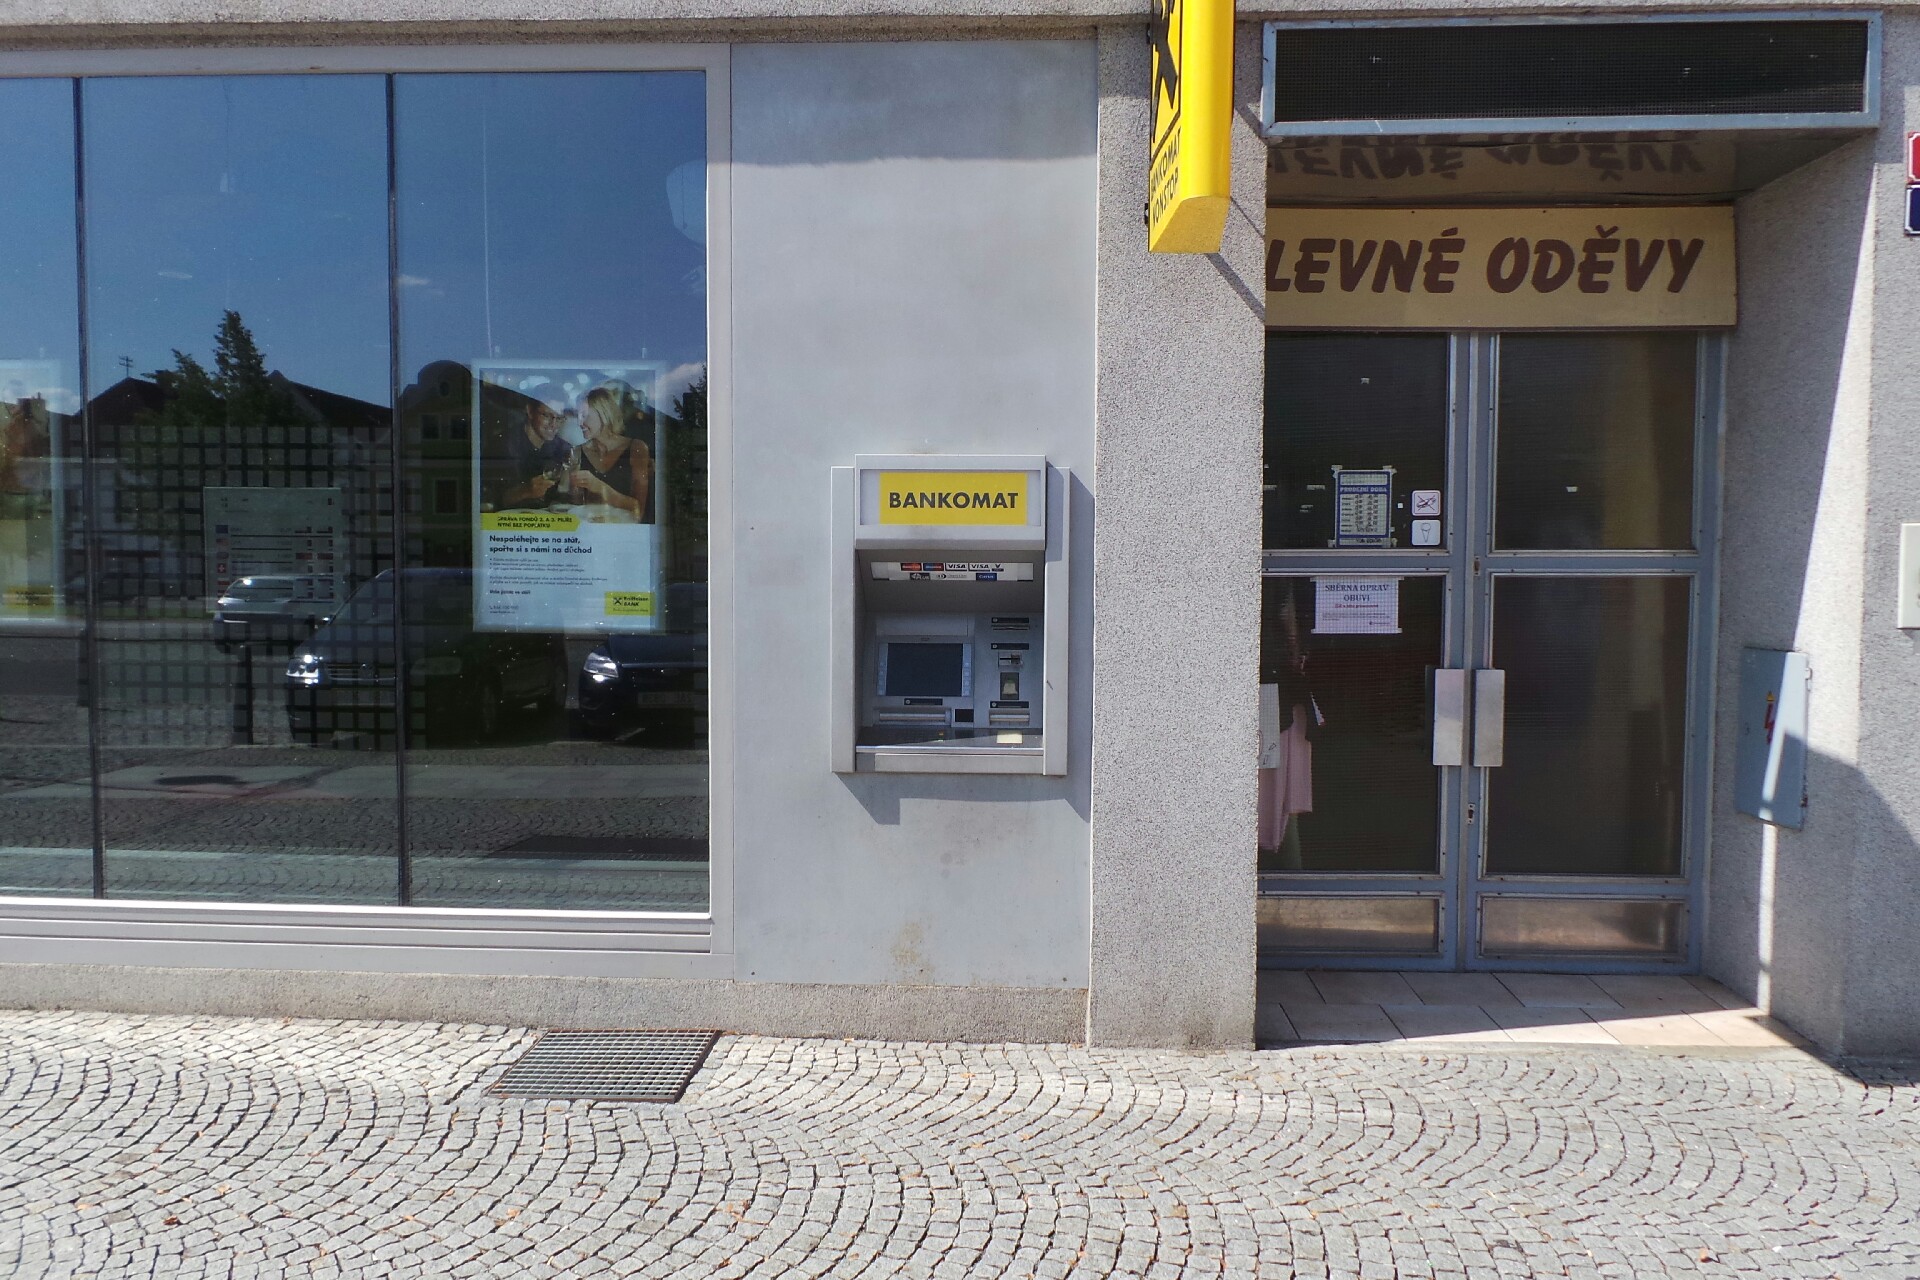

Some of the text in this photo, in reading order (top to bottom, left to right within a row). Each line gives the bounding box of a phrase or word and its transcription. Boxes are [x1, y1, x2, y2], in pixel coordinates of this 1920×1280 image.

[1153, 166, 1179, 228] NONSTOP
[1265, 224, 1704, 294] LEVNÉ ODĚVY
[889, 492, 1019, 509] BANKOMAT
[489, 535, 539, 545] Nespoléhejte
[564, 536, 581, 544] stát,
[489, 545, 514, 554] spořte
[564, 546, 592, 554] důchod
[1325, 583, 1389, 592] SBĚRNA OPRAV
